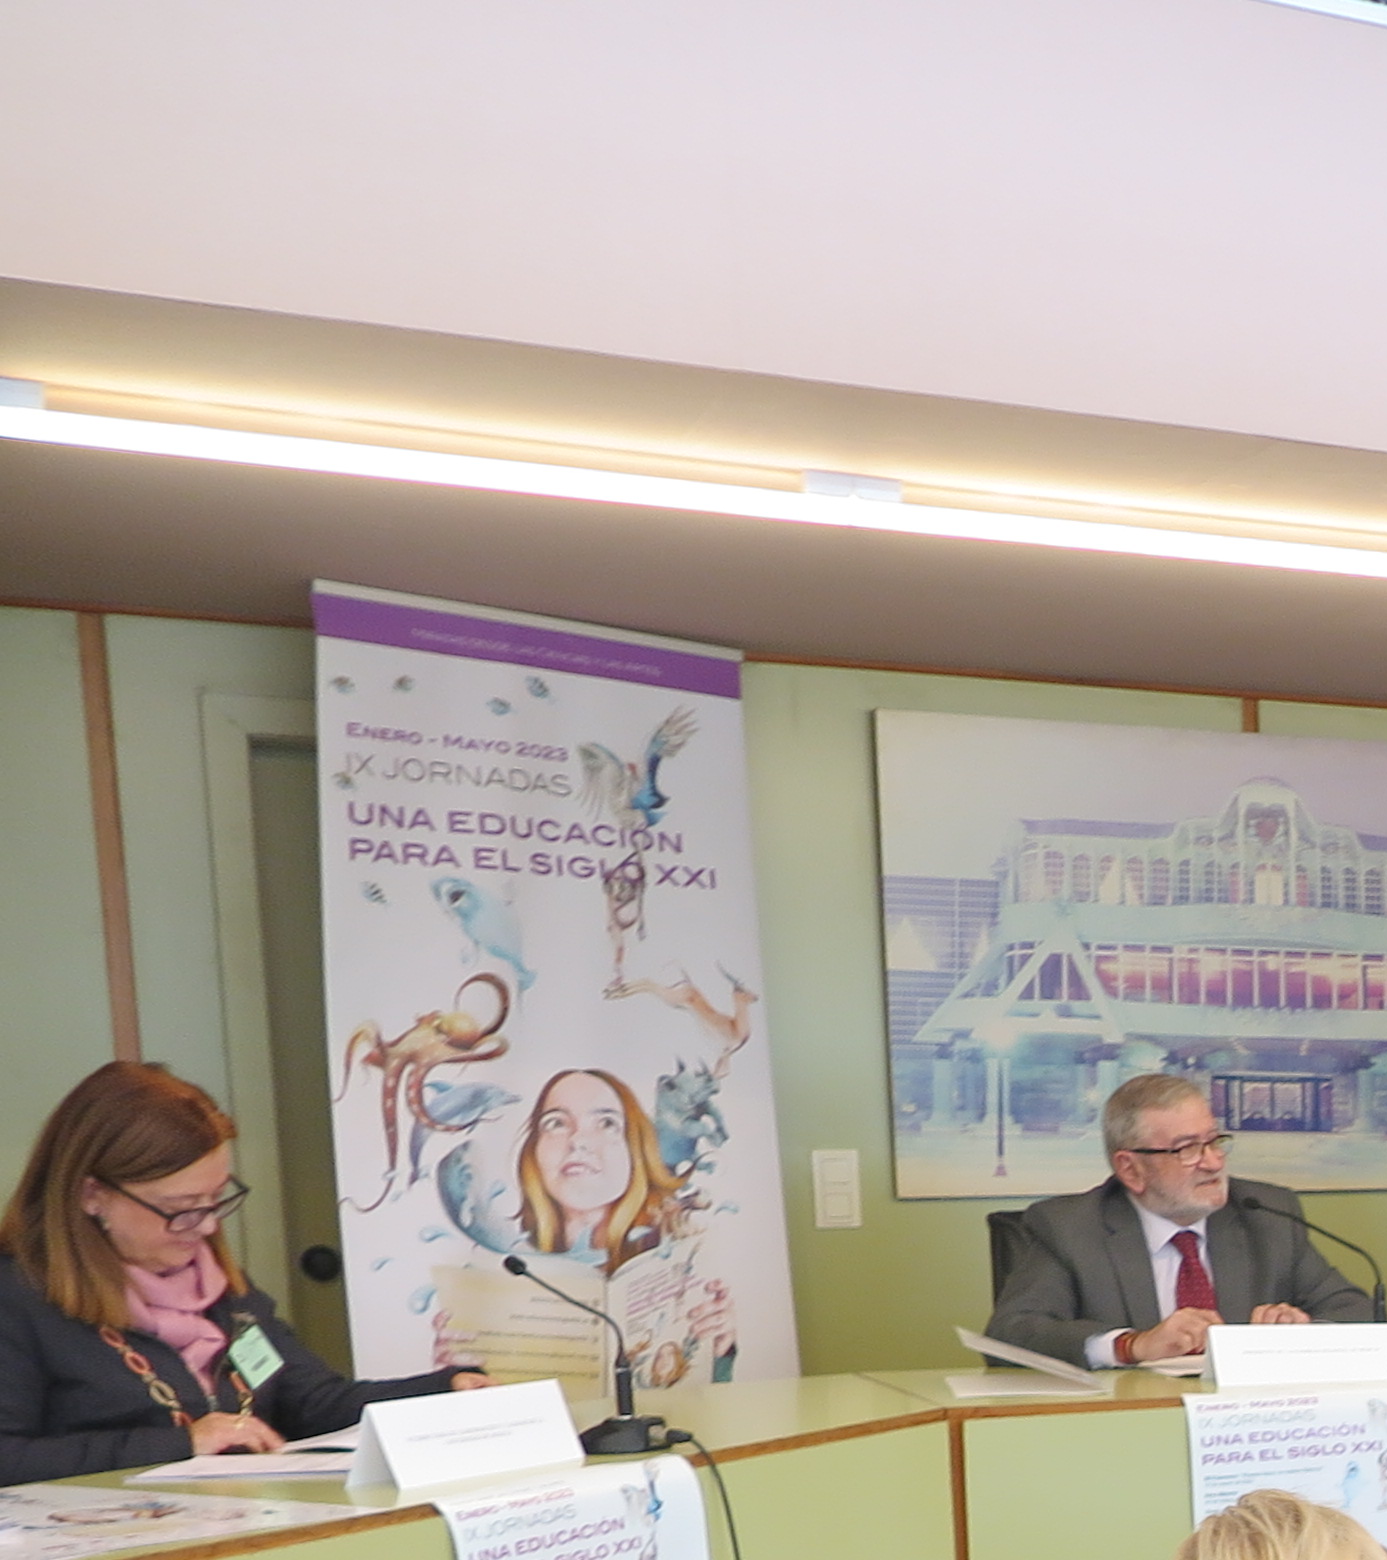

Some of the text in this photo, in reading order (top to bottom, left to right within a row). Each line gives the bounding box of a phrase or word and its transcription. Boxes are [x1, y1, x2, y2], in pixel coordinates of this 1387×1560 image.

[346, 722, 424, 744] ENERO
[442, 735, 511, 754] MAYO
[515, 742, 569, 762] 2023
[381, 758, 572, 798] JORNADAS
[349, 801, 436, 831] UNA
[349, 838, 717, 889] PARA EL SIGLO XXI
[1201, 1433, 1244, 1448] UNA
[1202, 1440, 1383, 1465] PARA EL SIGLO XXI
[613, 1536, 643, 1554] XXI
